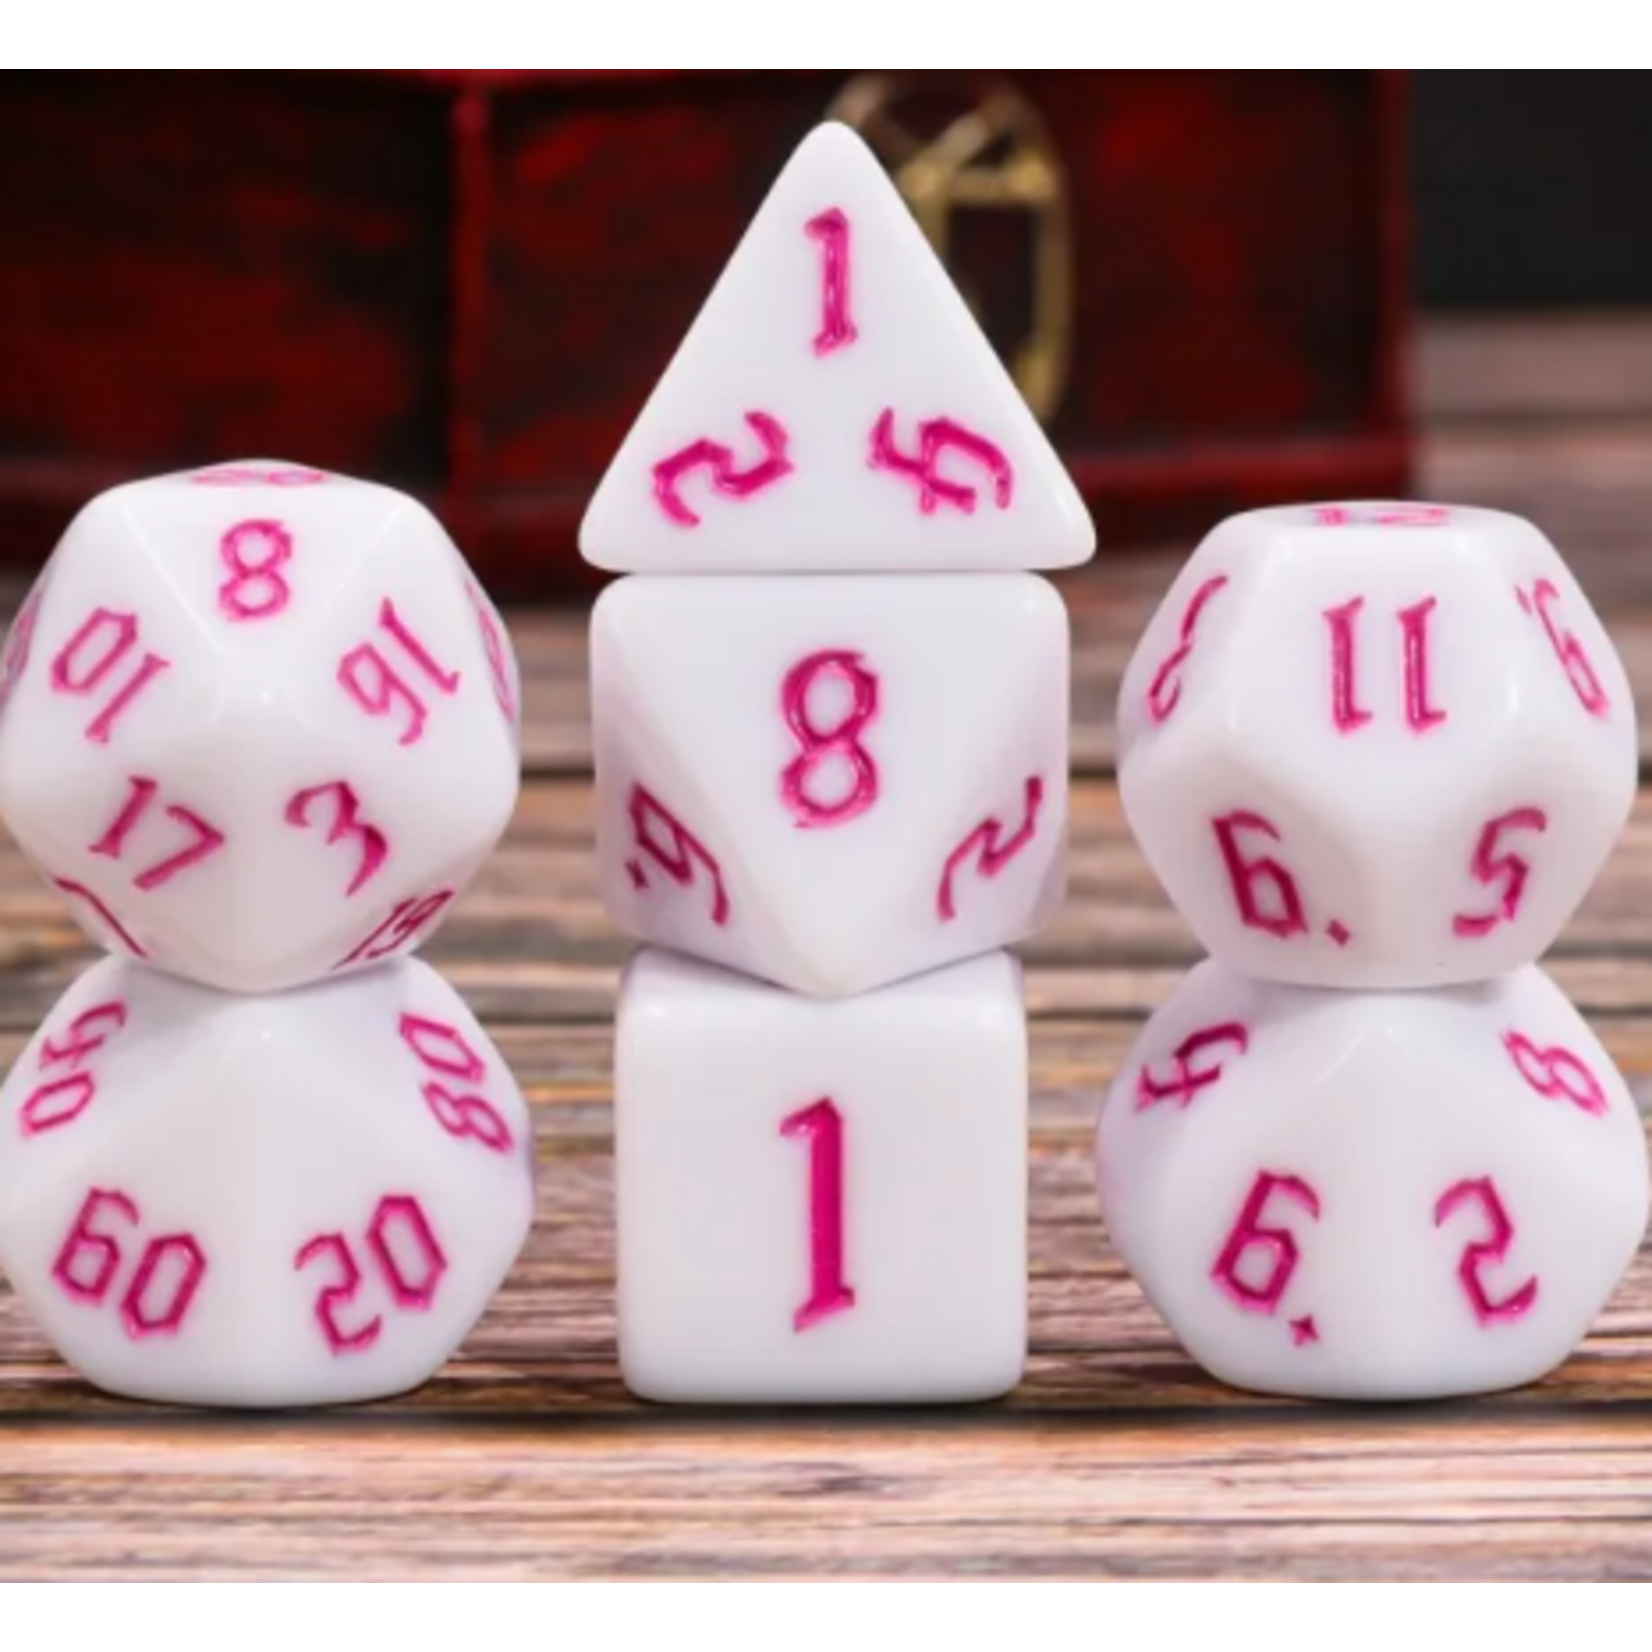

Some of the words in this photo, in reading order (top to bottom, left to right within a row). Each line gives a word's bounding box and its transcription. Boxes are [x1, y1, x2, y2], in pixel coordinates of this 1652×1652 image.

[803, 206, 858, 358] 1
[649, 409, 796, 529] 2
[866, 407, 1015, 517] 4
[217, 517, 294, 623] 8
[49, 606, 171, 745] 10
[336, 596, 461, 747] 16
[1322, 596, 1447, 736] 11
[778, 646, 883, 831] 8
[86, 773, 226, 893] 17
[283, 778, 393, 897] 3
[1133, 1018, 1252, 1113] 4
[1500, 1028, 1610, 1117] 8
[48, 1185, 209, 1343] 60
[292, 1191, 451, 1358] 20
[777, 1096, 858, 1334] 1
[1433, 1175, 1540, 1329] 2
